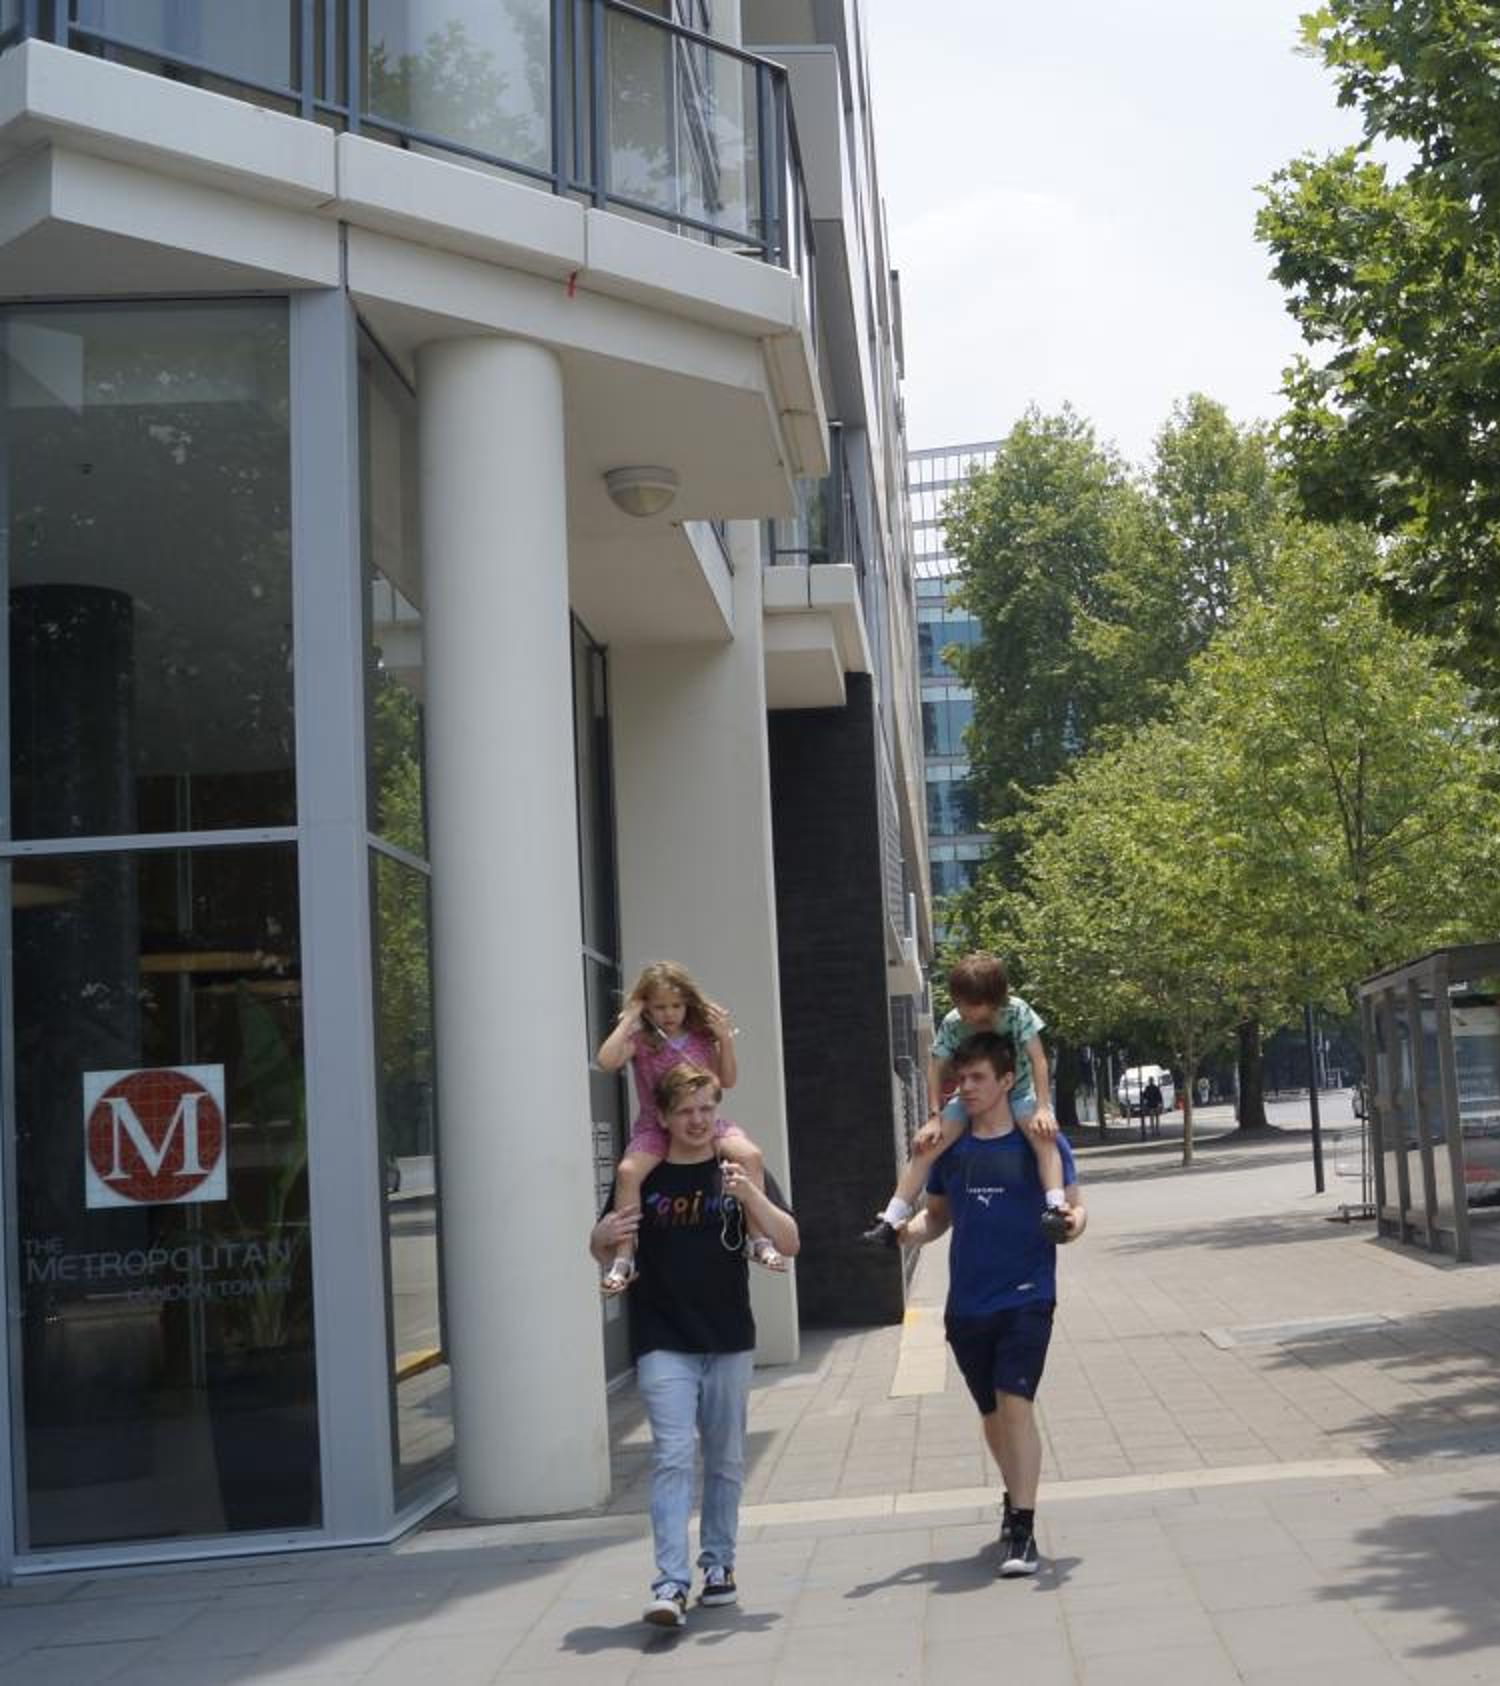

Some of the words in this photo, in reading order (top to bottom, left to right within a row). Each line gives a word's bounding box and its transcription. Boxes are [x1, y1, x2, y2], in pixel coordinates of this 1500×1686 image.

[101, 1092, 209, 1181] M
[24, 1238, 64, 1256] THE
[27, 1240, 291, 1283] METROPOLITAN
